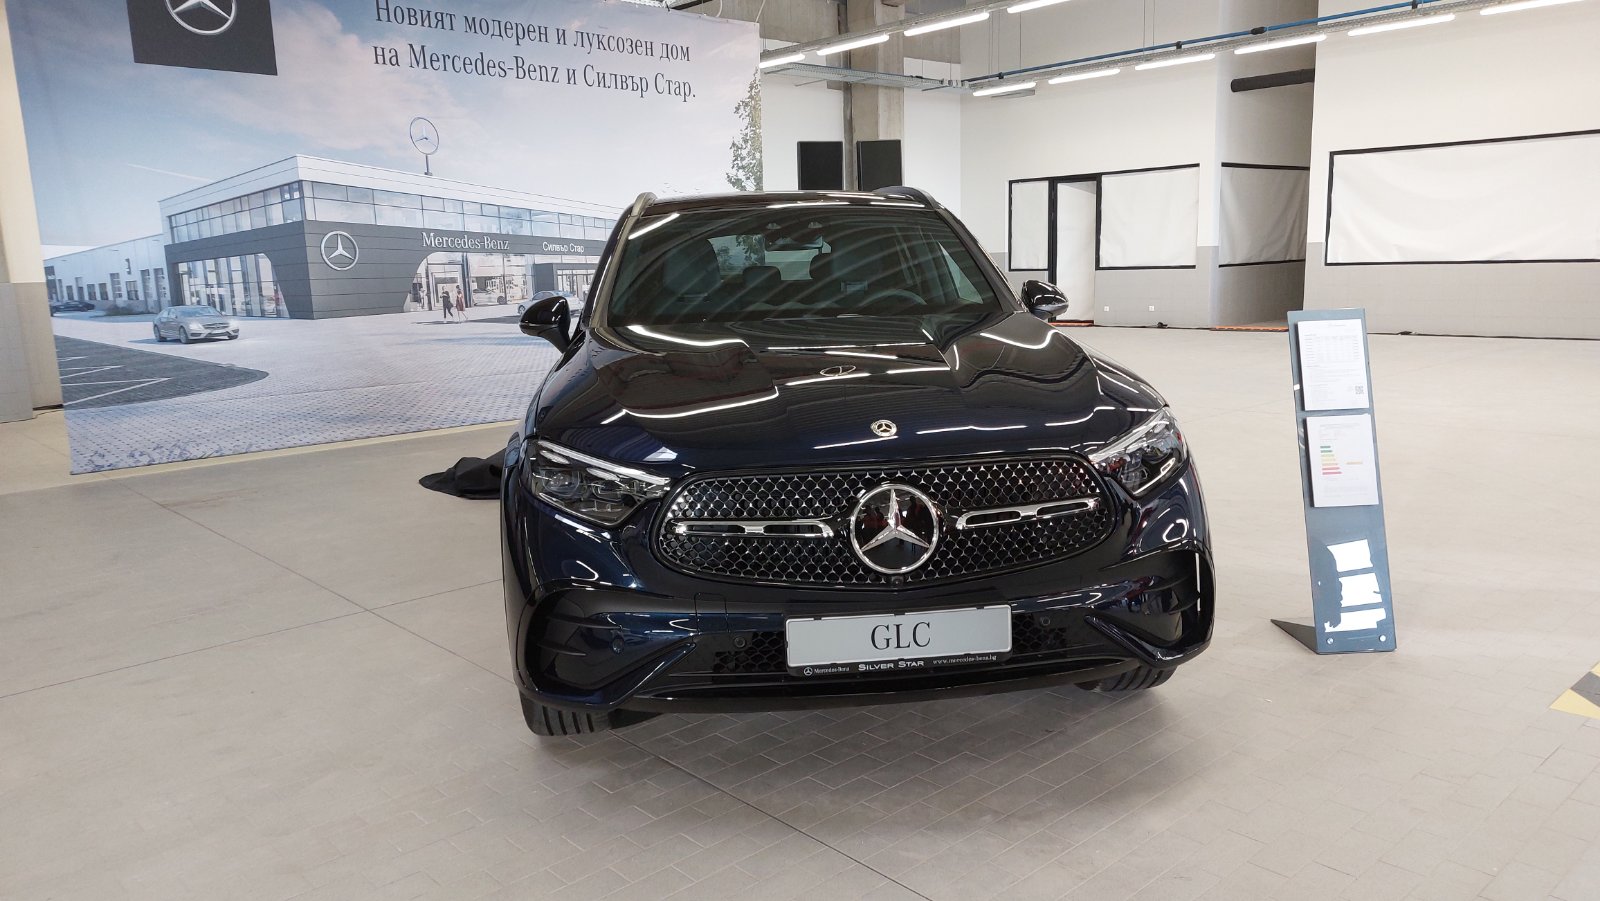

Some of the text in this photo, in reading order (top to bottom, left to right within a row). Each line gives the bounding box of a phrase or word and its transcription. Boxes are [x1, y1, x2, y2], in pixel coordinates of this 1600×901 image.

[375, 0, 691, 62] Новият модерен и луксозен дом
[372, 43, 696, 102] на Mercedes-Benz и Силвър Стар.
[421, 231, 510, 250] Mercedes-Benz
[542, 241, 585, 254] Силвър Стар
[870, 621, 932, 651] GLC
[858, 660, 925, 671] SILVER STAR
